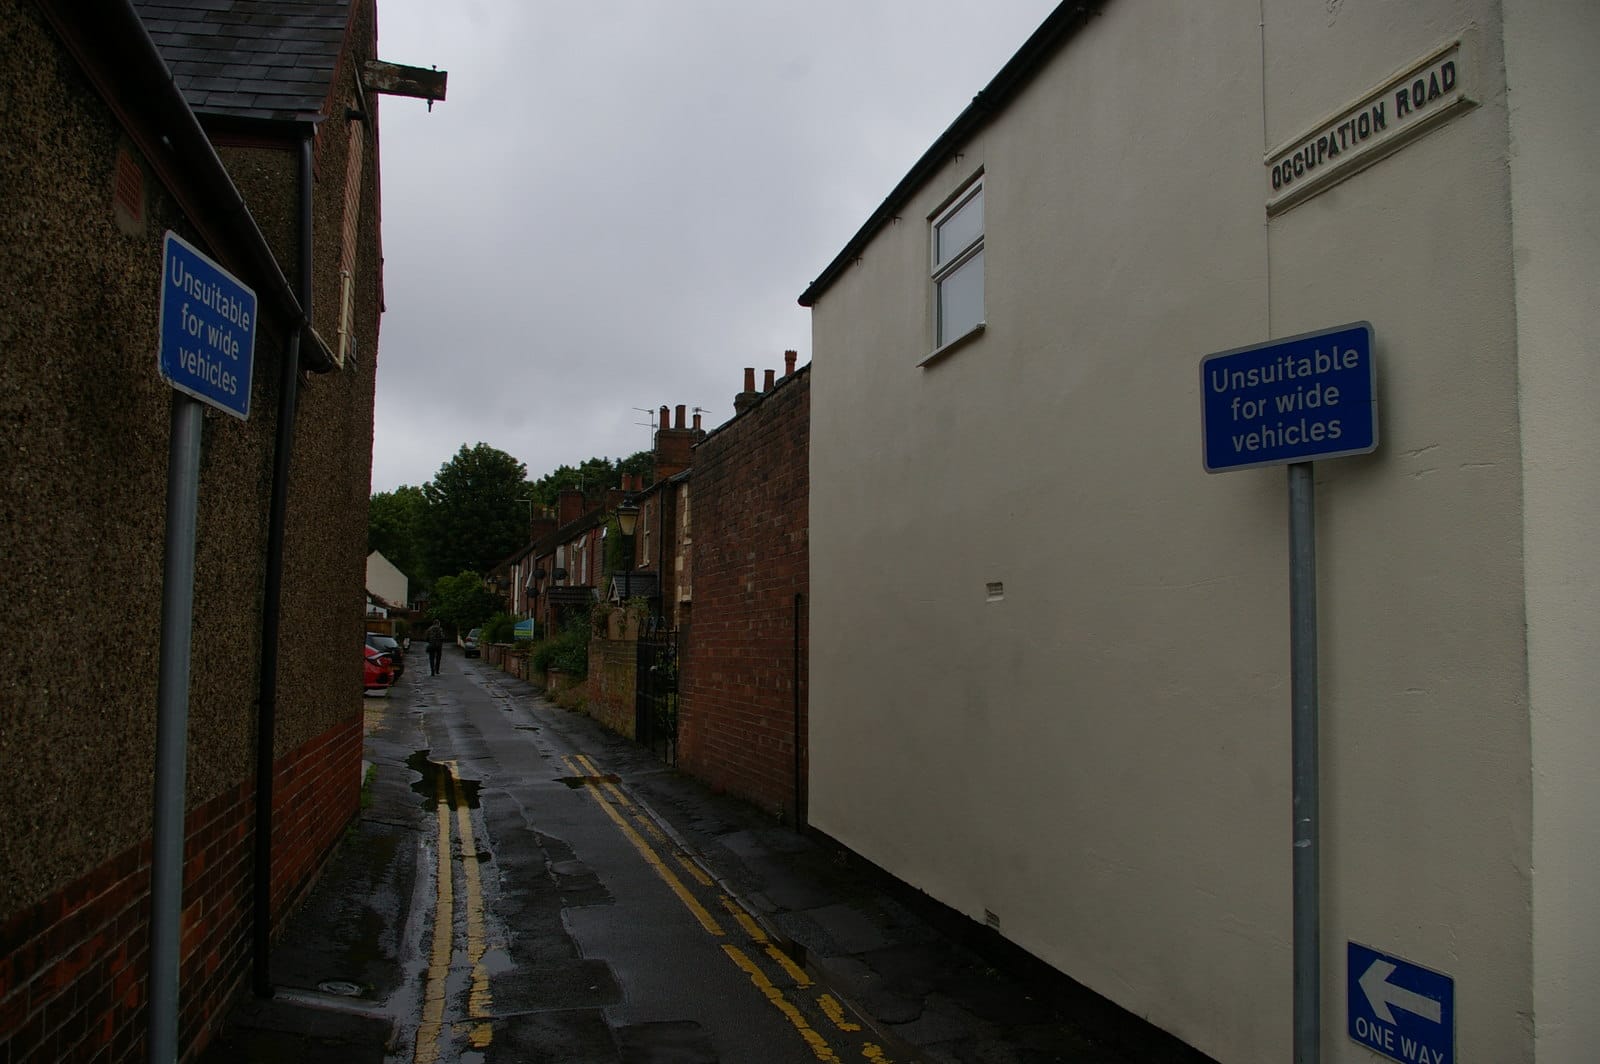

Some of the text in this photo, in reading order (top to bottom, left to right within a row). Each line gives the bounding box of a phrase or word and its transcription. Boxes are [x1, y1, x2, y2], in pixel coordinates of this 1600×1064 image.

[1271, 61, 1456, 190] OCCUPATION ROAD
[171, 255, 250, 332] Unsuitable
[181, 303, 239, 361] for wide
[179, 347, 237, 395] vehicles
[1212, 346, 1359, 393] Unsuitable
[1231, 383, 1340, 421] for wide
[1232, 418, 1342, 452] vehicles
[1355, 1016, 1394, 1051] ONE
